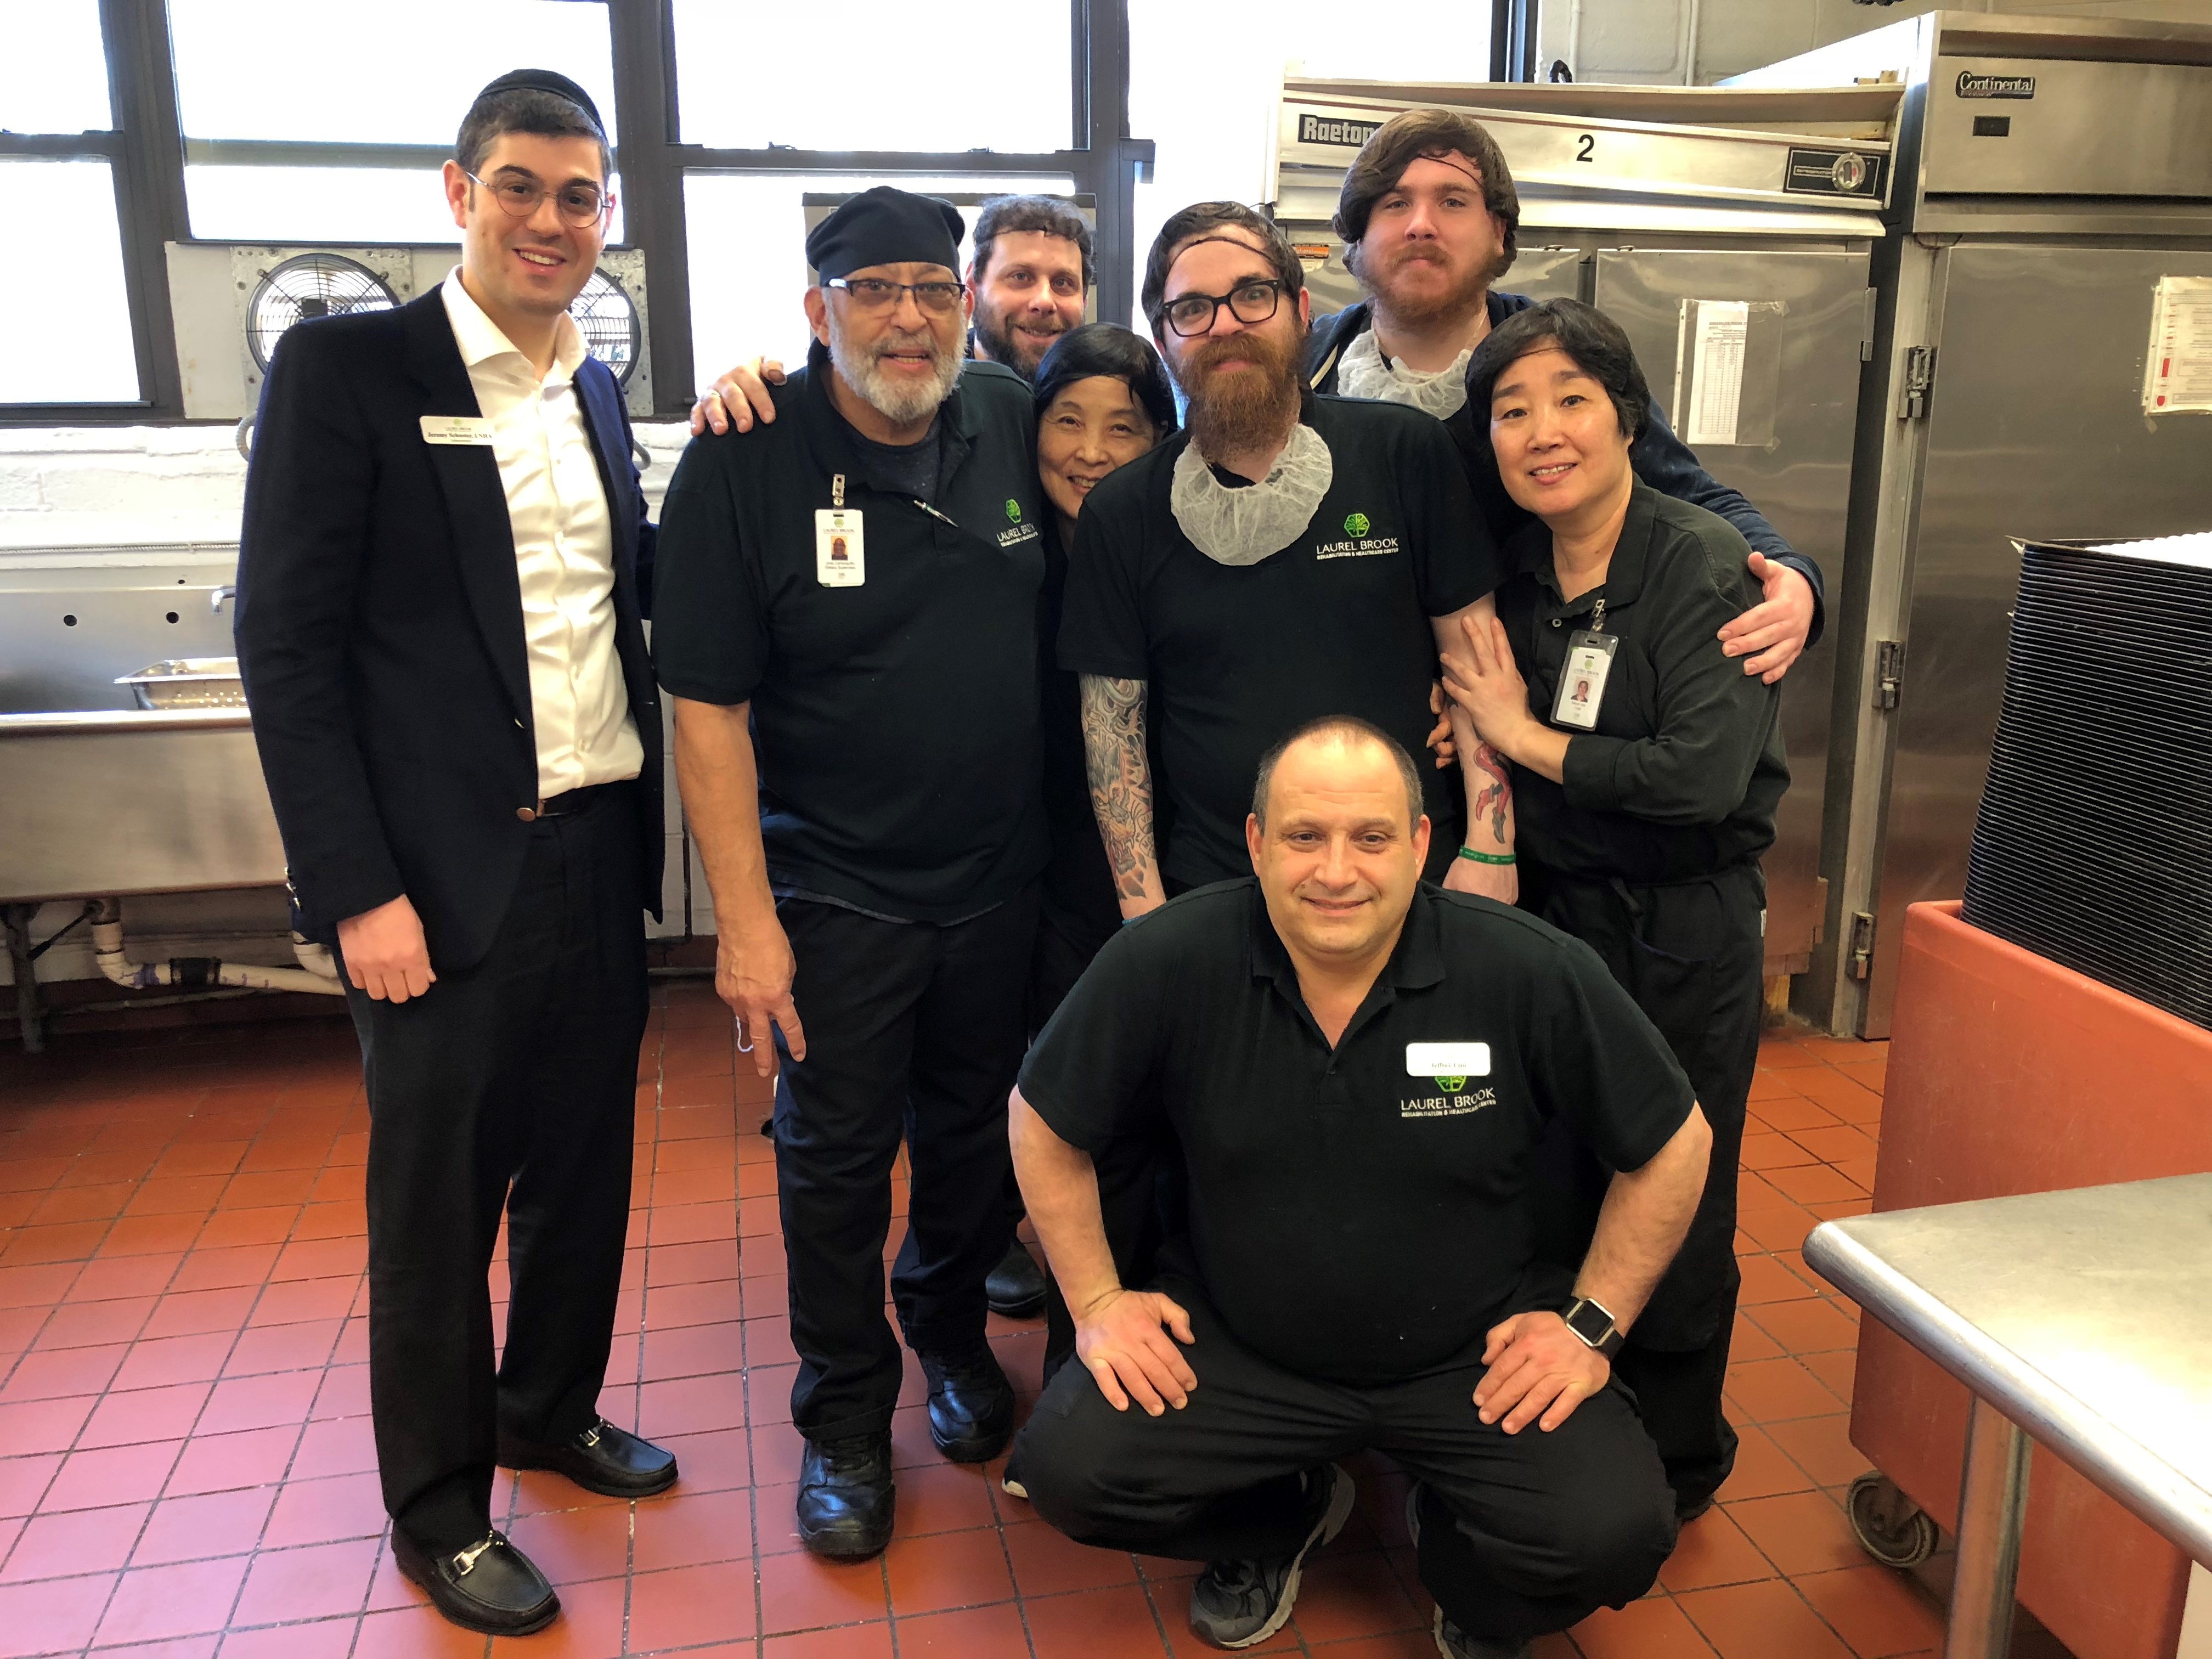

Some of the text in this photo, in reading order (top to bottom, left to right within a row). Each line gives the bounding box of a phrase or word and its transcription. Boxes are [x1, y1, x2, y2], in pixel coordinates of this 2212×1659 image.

[1960, 72, 2033, 91] Continental
[1304, 117, 1375, 144] Raeton
[1576, 134, 1595, 162] 2
[996, 527, 1022, 542] LAUREL
[1317, 538, 1398, 554] LAUREL BROOK
[1317, 551, 1351, 560] REHABILITATION
[1401, 1087, 1496, 1110] LAUREL BROOK
